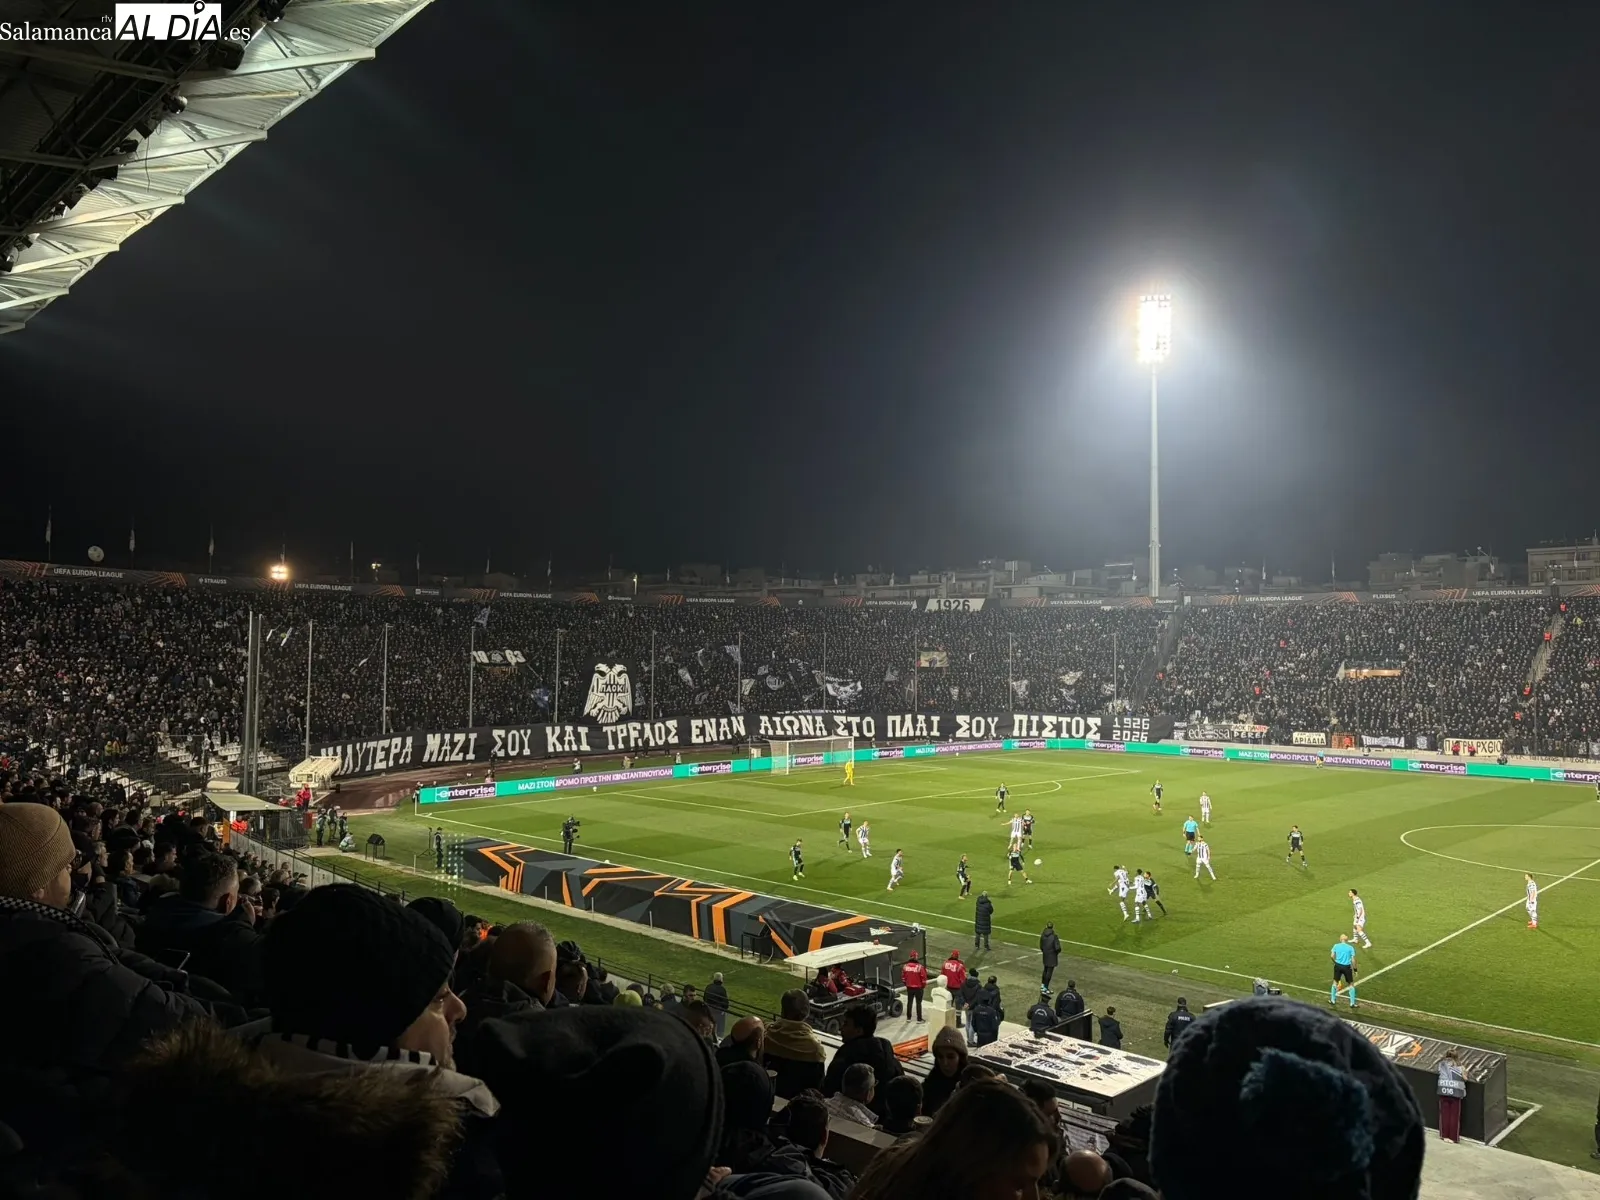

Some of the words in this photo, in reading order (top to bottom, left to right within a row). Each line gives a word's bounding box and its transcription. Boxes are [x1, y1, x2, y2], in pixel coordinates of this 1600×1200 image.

[72, 569, 98, 577] EUROPA
[98, 570, 124, 579] LEAGUE
[331, 584, 352, 592] LEAGUE
[935, 599, 971, 611] 1926
[1112, 717, 1150, 729] 1926
[422, 733, 478, 763] ΜΑΖΙ
[492, 729, 532, 757] ΣΟΥ
[546, 725, 591, 753] ΚΑΙ
[602, 719, 679, 751] ΤΡΕΛΟΣ
[690, 715, 747, 744] ΕΝΑΝ
[759, 714, 828, 736] ΑΙΩΝΑ
[833, 715, 876, 737] ΣΤΟ
[887, 714, 941, 738] ΠΛΑΙ
[956, 714, 999, 738] ΣΟΥ
[1012, 714, 1102, 740] ΠΙΣΤΟΣ
[1112, 730, 1148, 743] 2026
[1013, 740, 1046, 748] enterprise
[1087, 741, 1124, 750] enterprise
[874, 748, 904, 757] enterprise
[1183, 748, 1224, 756] enterprise
[1292, 754, 1309, 762] ΠΡΟΣ
[691, 763, 732, 773] enterprise
[1413, 762, 1465, 773] enterprise
[518, 781, 536, 791] ΜΑΖΙ
[536, 780, 555, 789] ΣΤΟΝ
[580, 776, 598, 784] ΠΡΟΣ
[598, 774, 612, 783] ΤΗΝ
[440, 785, 495, 798] enterprise
